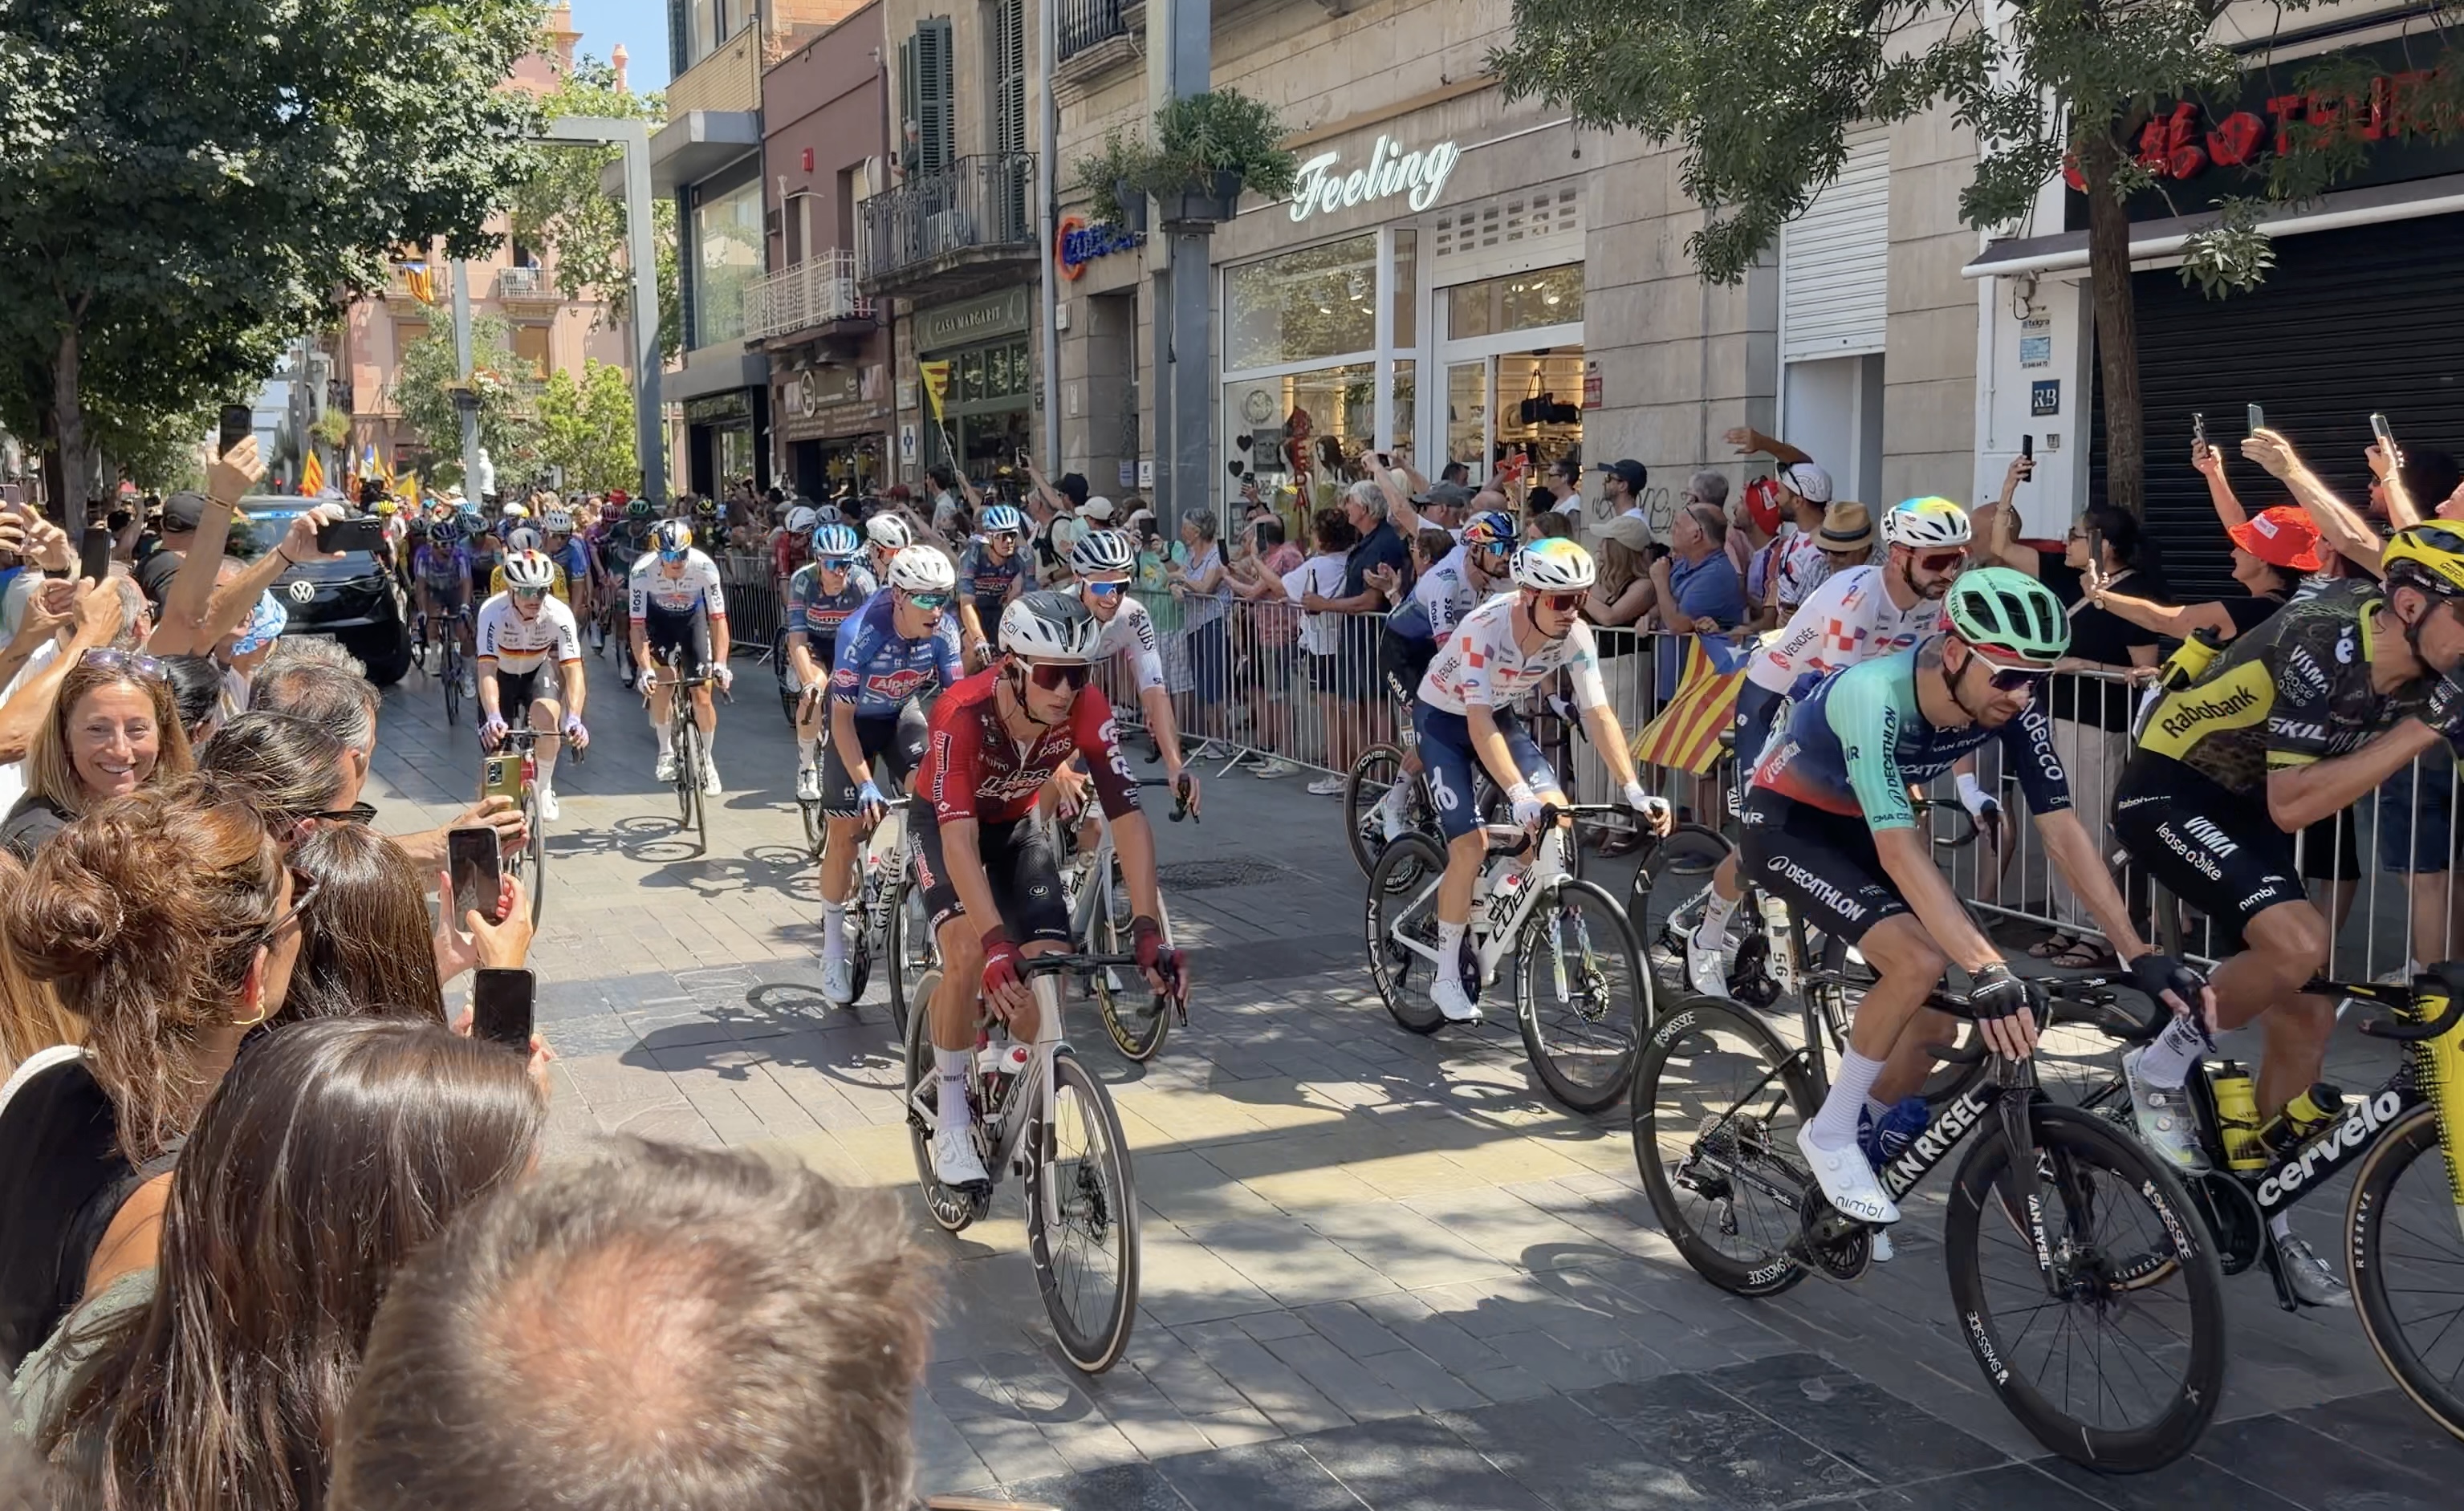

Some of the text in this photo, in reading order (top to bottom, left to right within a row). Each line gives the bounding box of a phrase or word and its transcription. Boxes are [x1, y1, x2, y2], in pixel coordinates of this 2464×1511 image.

[1290, 135, 1462, 222] Feeling
[935, 306, 1001, 335] CASA MARGARIT
[2034, 388, 2057, 408] RB
[632, 588, 642, 612] BOSS
[1136, 624, 1155, 652] UBS
[1783, 628, 1820, 657] VENDÉE
[875, 668, 933, 692] Alpecin
[1387, 671, 1407, 701] BORA
[2290, 644, 2328, 694] VISMA
[2161, 685, 2259, 739] Rabobank
[2267, 717, 2327, 741] SKIL
[1882, 705, 1901, 798] DECATHLON
[2156, 821, 2188, 855] lease
[2182, 815, 2239, 860] VISMA
[1491, 866, 1536, 943] CUBE
[1784, 863, 1868, 922] DECATHLON
[2238, 885, 2277, 912] nimbl
[1773, 952, 1789, 977] 56
[1913, 1092, 1988, 1162] RYSEL
[2257, 1091, 2401, 1207] cervélo
[1835, 1195, 1885, 1219] nimbl
[2027, 1194, 2051, 1271] VAN RYSEL
[2354, 1191, 2372, 1269] RESERVE
